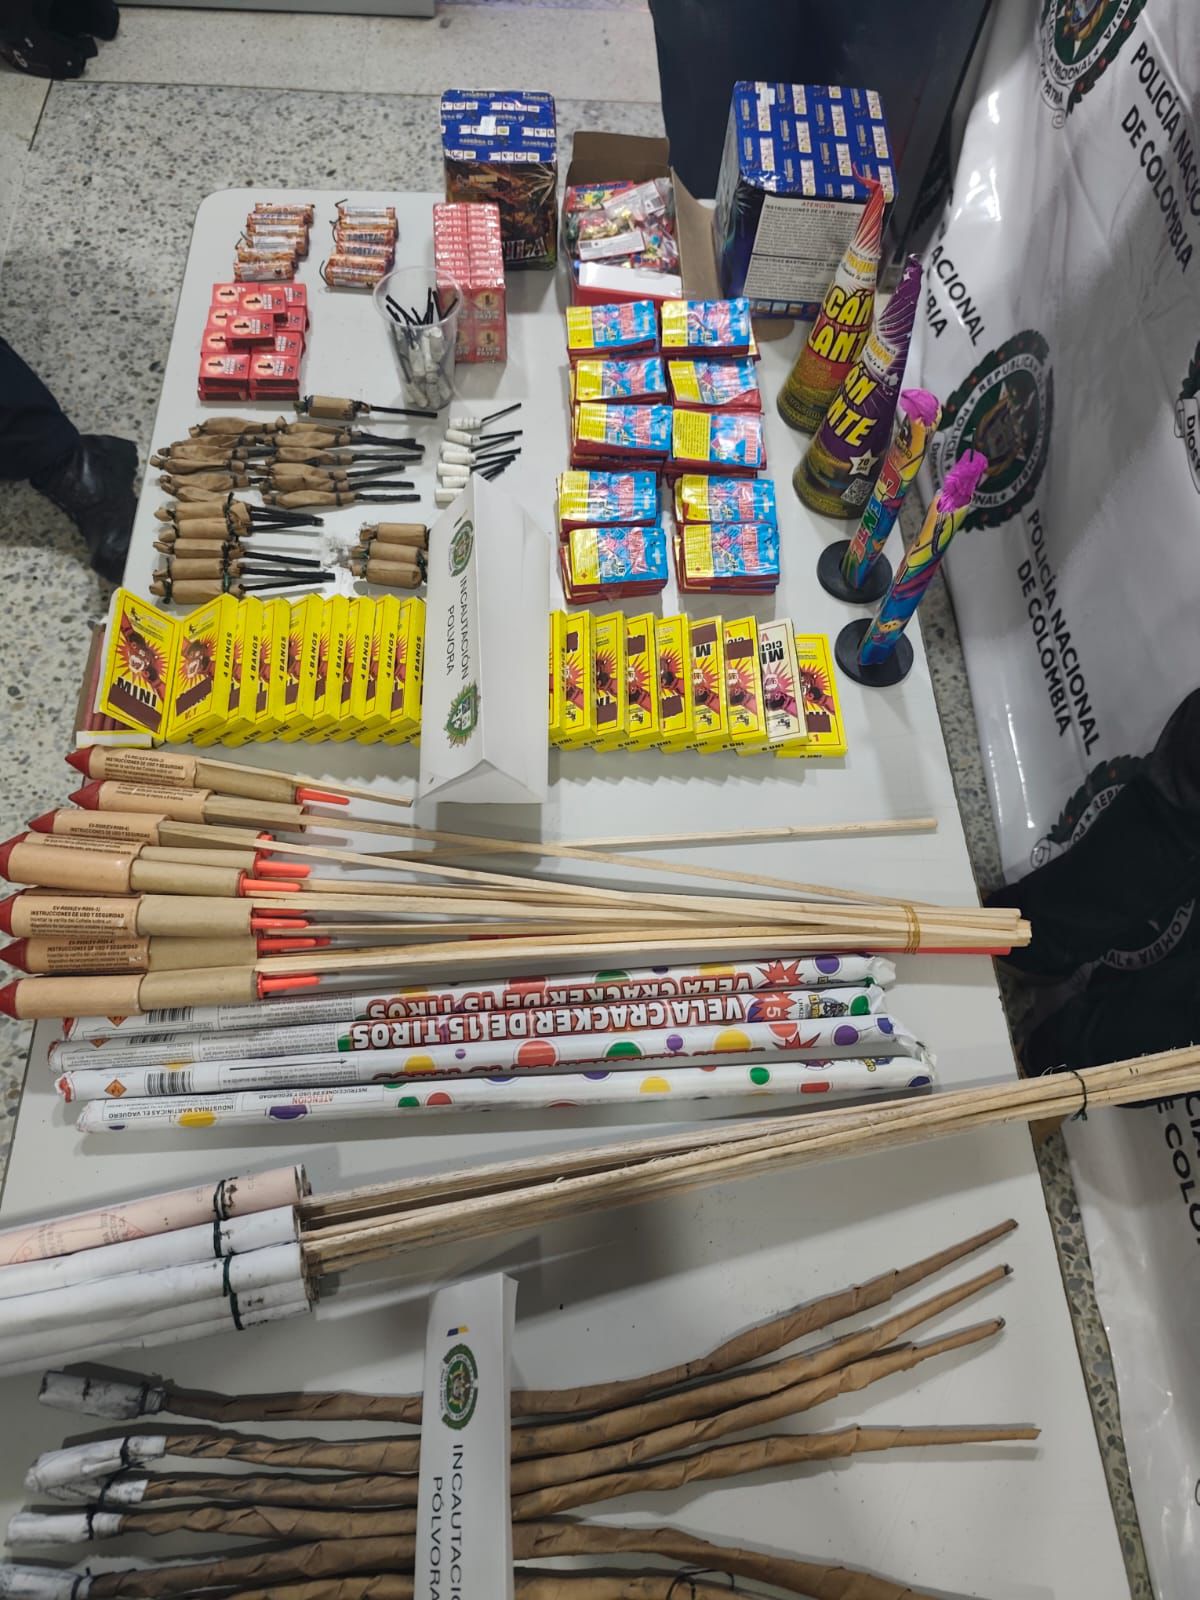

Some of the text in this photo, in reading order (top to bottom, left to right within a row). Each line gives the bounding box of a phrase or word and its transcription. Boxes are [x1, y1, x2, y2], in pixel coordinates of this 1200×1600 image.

[1130, 41, 1200, 217] POLICÍA NACIO
[1121, 104, 1193, 273] DE COLOMBIA
[931, 245, 987, 346] ACIONAL
[224, 631, 232, 669] BANGS
[387, 632, 395, 670] BANGS
[1017, 560, 1072, 737] DE COLOMBIA
[1028, 508, 1058, 611] POLICÍA
[1050, 609, 1101, 756] NACIONAL
[251, 635, 259, 673] BANGS
[310, 632, 318, 671] BANGS
[116, 676, 157, 708] MINI
[448, 1014, 481, 1042] 15
[491, 1012, 529, 1038] DE
[535, 997, 661, 1035] CRACKER
[671, 997, 743, 1024] VELA
[352, 1018, 441, 1050] TIROS
[1165, 1122, 1200, 1233] COLO
